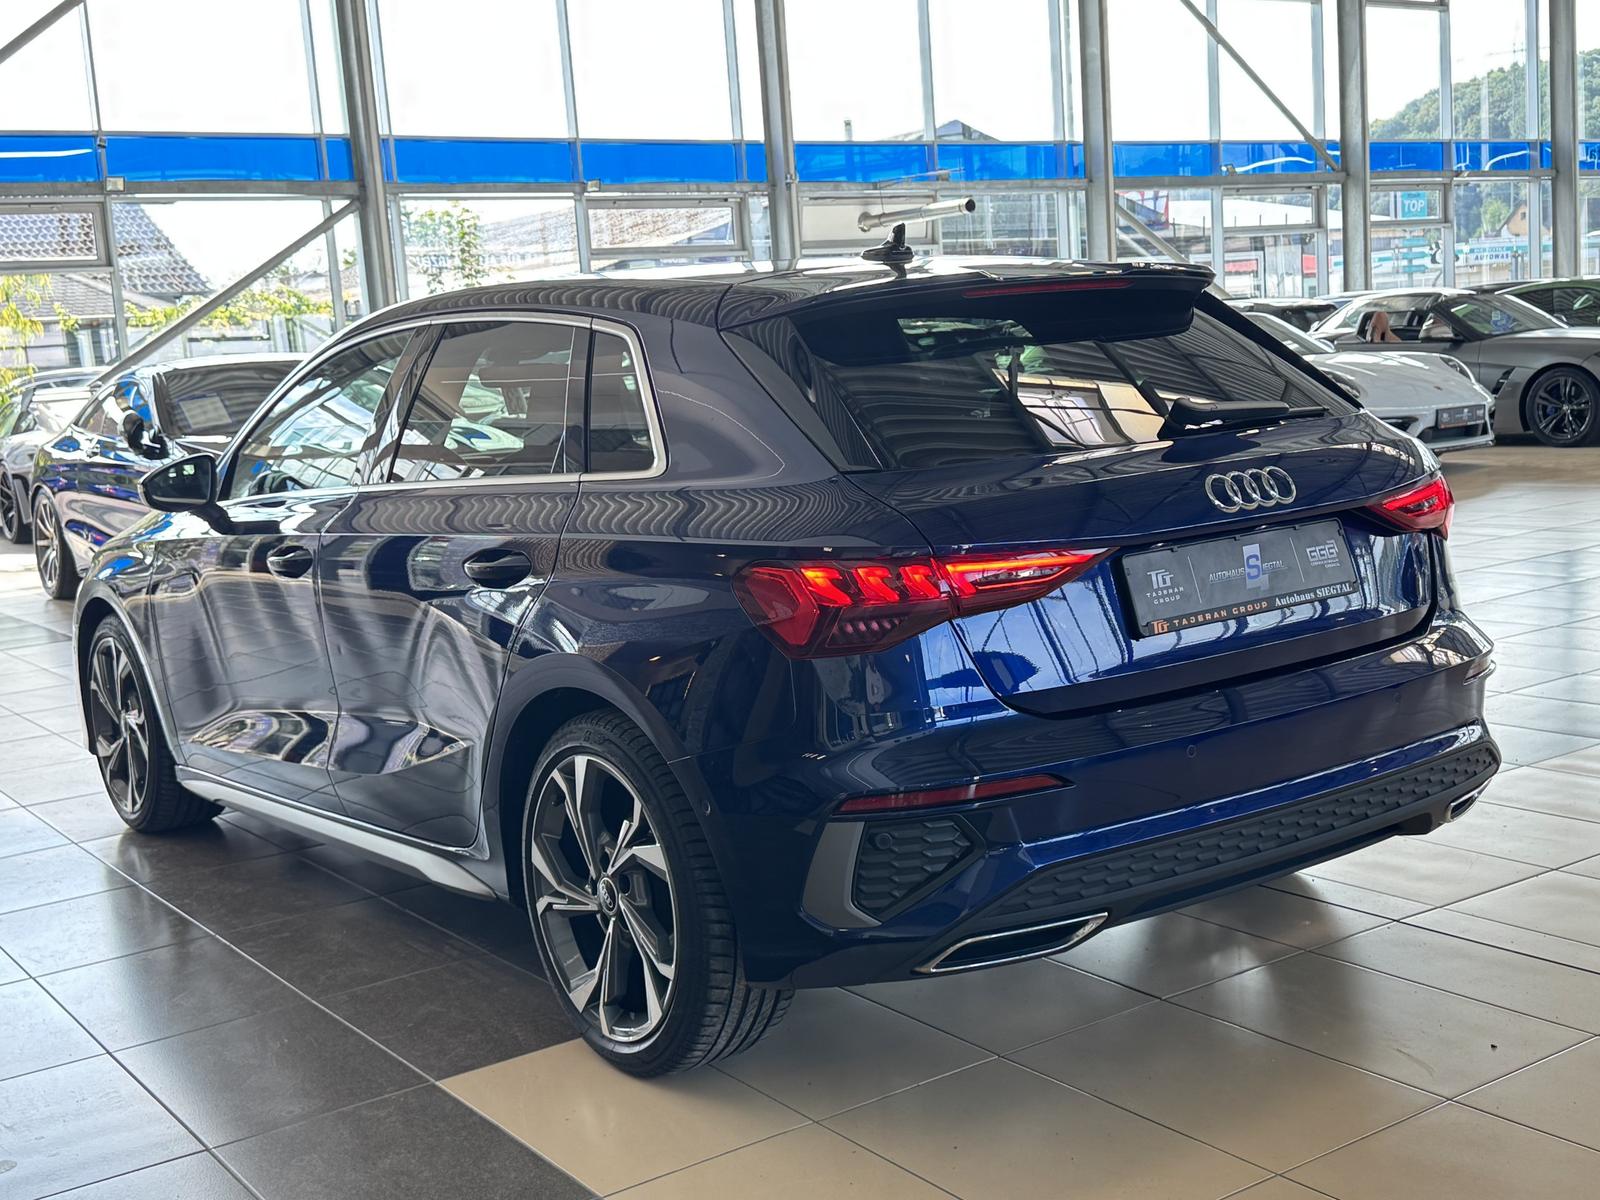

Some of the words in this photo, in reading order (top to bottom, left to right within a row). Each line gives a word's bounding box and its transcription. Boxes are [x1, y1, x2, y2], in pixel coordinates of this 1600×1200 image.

[1404, 200, 1424, 212] TOP
[1209, 567, 1245, 582] AUTOHAUS
[1146, 586, 1184, 598] TAJERAN
[1153, 595, 1180, 605] GROUP
[1173, 610, 1227, 627] TAJERAN
[1232, 601, 1268, 615] GROUP
[1275, 591, 1315, 607] Autohaus
[1316, 583, 1353, 598] SIEGTAL
